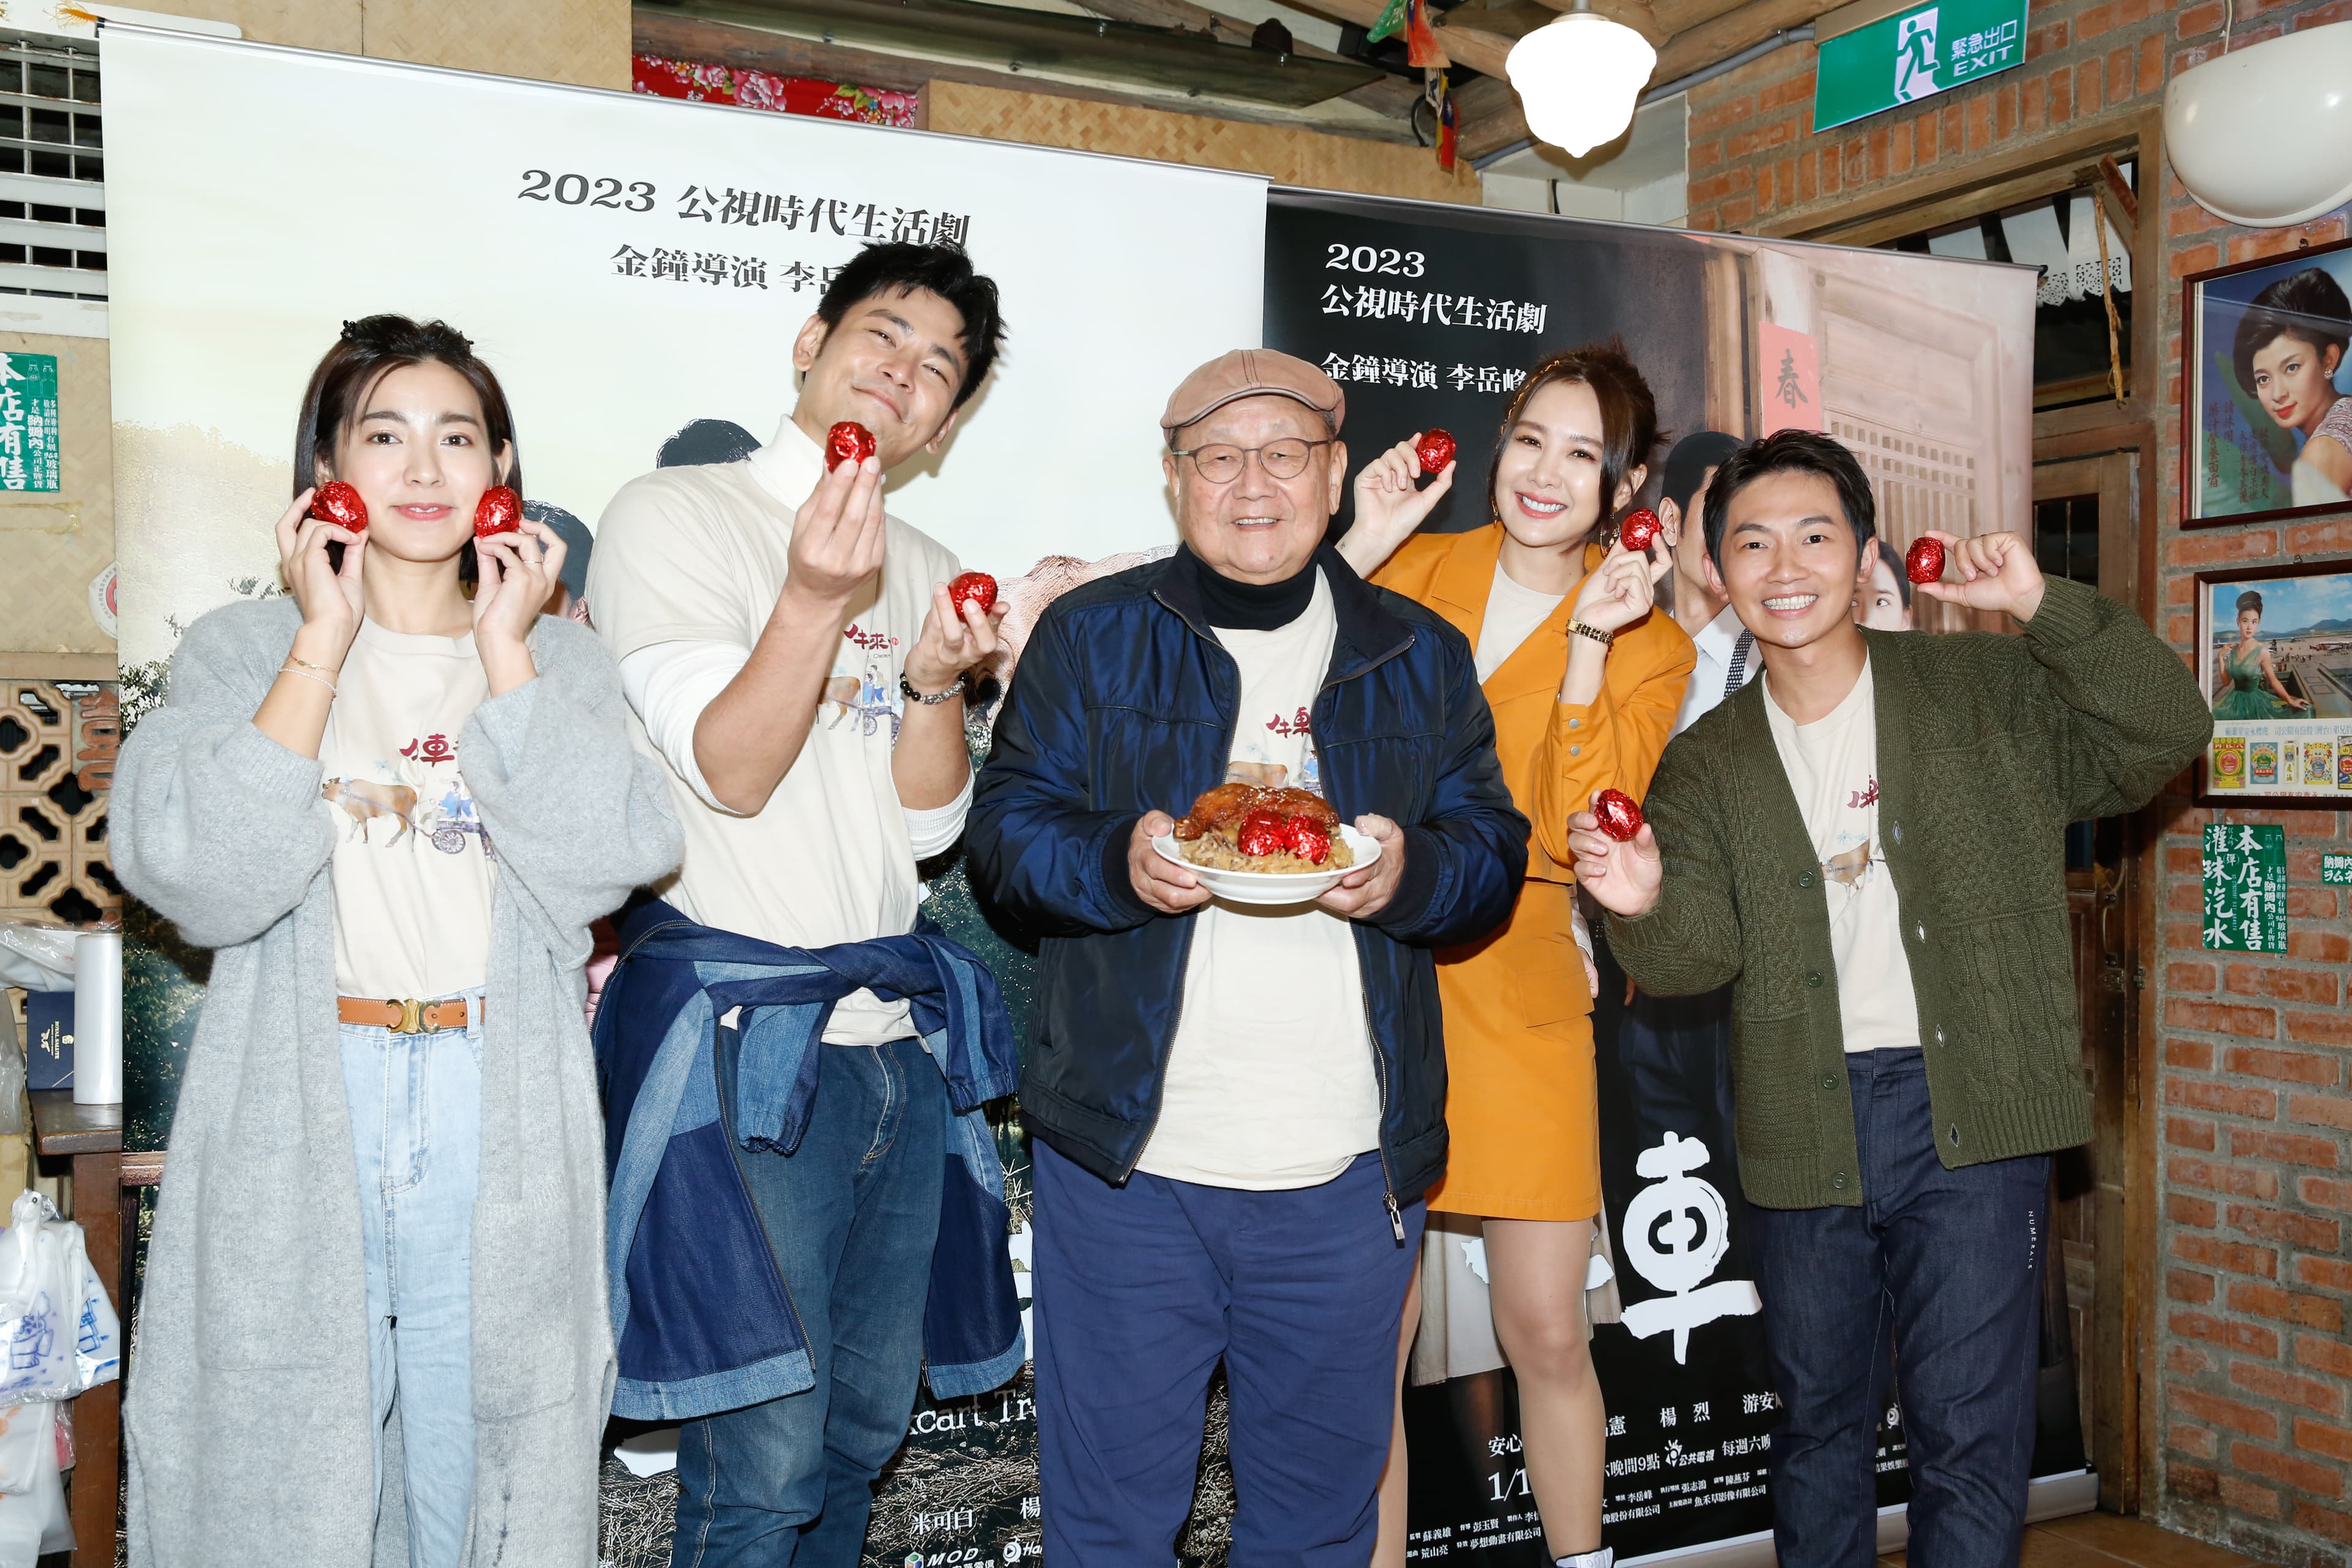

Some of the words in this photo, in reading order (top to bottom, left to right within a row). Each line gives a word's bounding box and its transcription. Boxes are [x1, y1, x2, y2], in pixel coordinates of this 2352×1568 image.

[1951, 19, 2018, 61] 緊急出口
[1953, 44, 2014, 77] EXIT
[518, 170, 655, 211] 2023
[677, 184, 971, 247] 公視時代生活劇
[610, 244, 768, 290] 金鐘導演
[1325, 243, 1425, 277] 2023
[1321, 284, 1548, 334] 公視時代生活劇
[1321, 352, 1438, 390] 金鐘導演
[1775, 348, 1809, 409] 春
[2234, 825, 2264, 951] 本店有售
[2028, 1211, 2037, 1269] NUMERALS
[995, 1389, 1036, 1423] Tr
[1605, 1415, 1626, 1437] 憲
[1679, 1449, 1715, 1467] 公共電視
[1627, 1490, 1653, 1504] 李岳峰
[911, 1506, 974, 1536] 米可白
[927, 1547, 979, 1567] MOD
[1023, 1541, 1042, 1556] Ha
